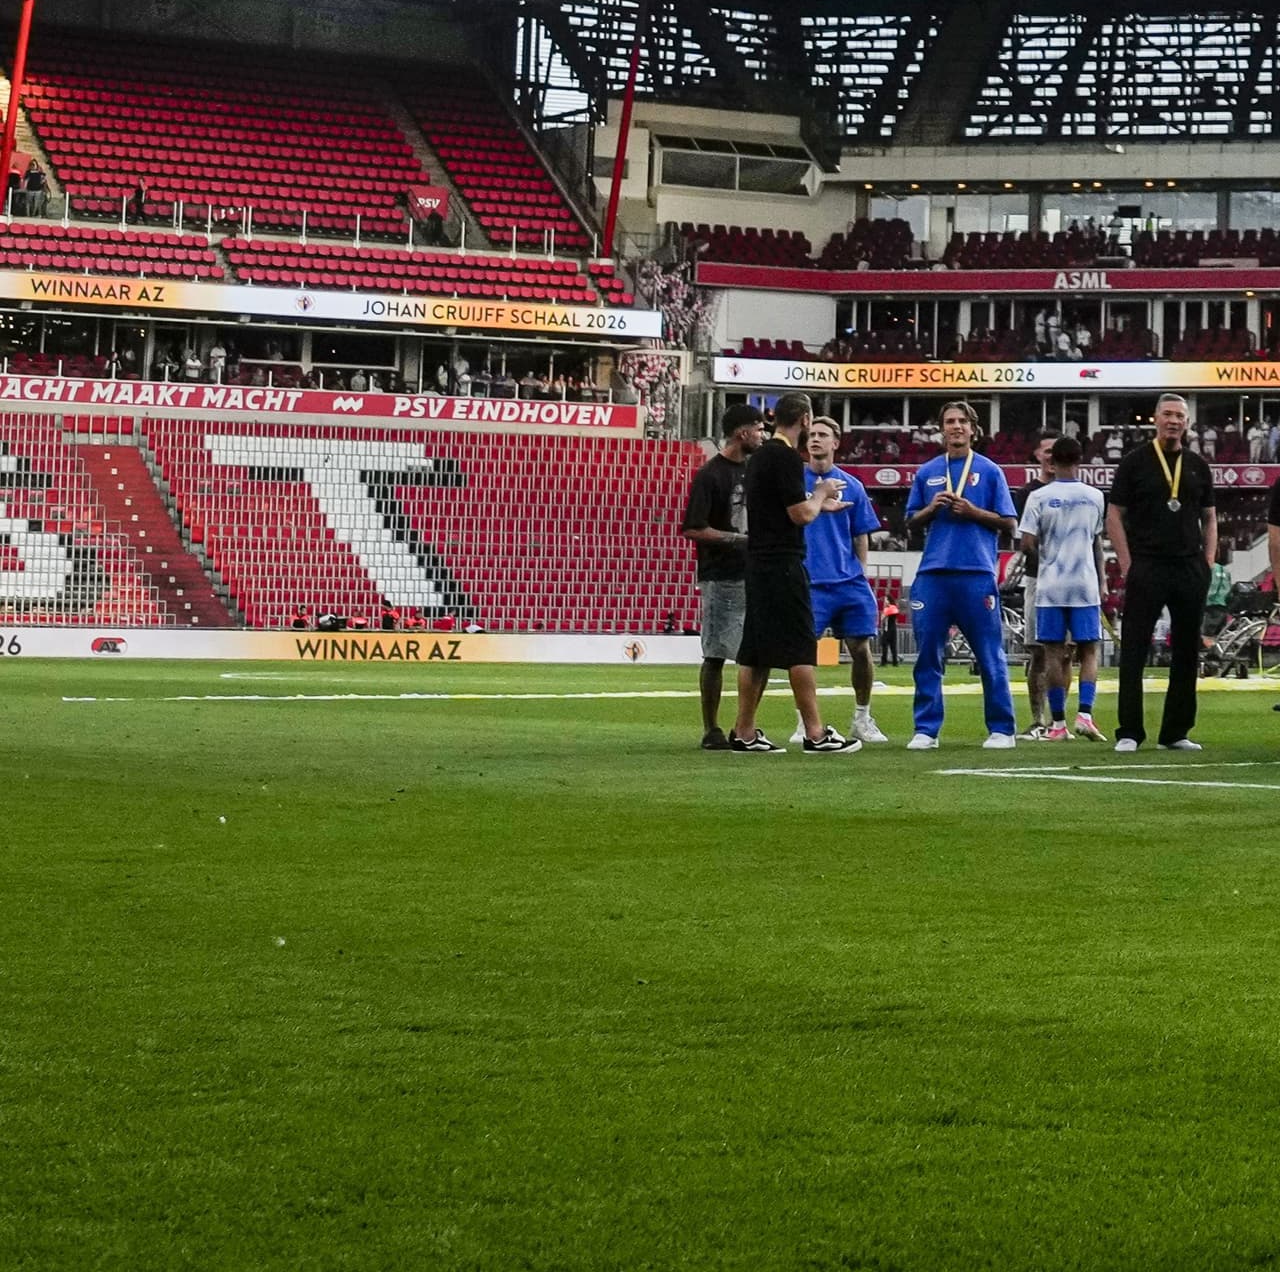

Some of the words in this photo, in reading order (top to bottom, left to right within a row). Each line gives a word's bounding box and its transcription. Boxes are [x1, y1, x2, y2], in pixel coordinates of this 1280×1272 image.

[31, 278, 131, 301] WINNAAR
[137, 285, 165, 303] AZ
[1054, 271, 1112, 289] ASML
[363, 299, 426, 320] JOHAN
[432, 304, 505, 324] CRUIJFF
[510, 309, 580, 328] SCHAAL
[587, 313, 627, 330] 2026
[784, 366, 839, 382] JOHAN
[844, 368, 915, 383] CRUIJFF
[920, 368, 989, 383] SCHAAL
[994, 368, 1035, 383] 2026
[90, 383, 197, 408] MAAKT
[201, 388, 303, 410] MACHT
[392, 396, 448, 418] PSV
[452, 399, 614, 426] EINDHOVEN
[296, 638, 420, 660] WINNAAR
[428, 640, 462, 660] AZ
